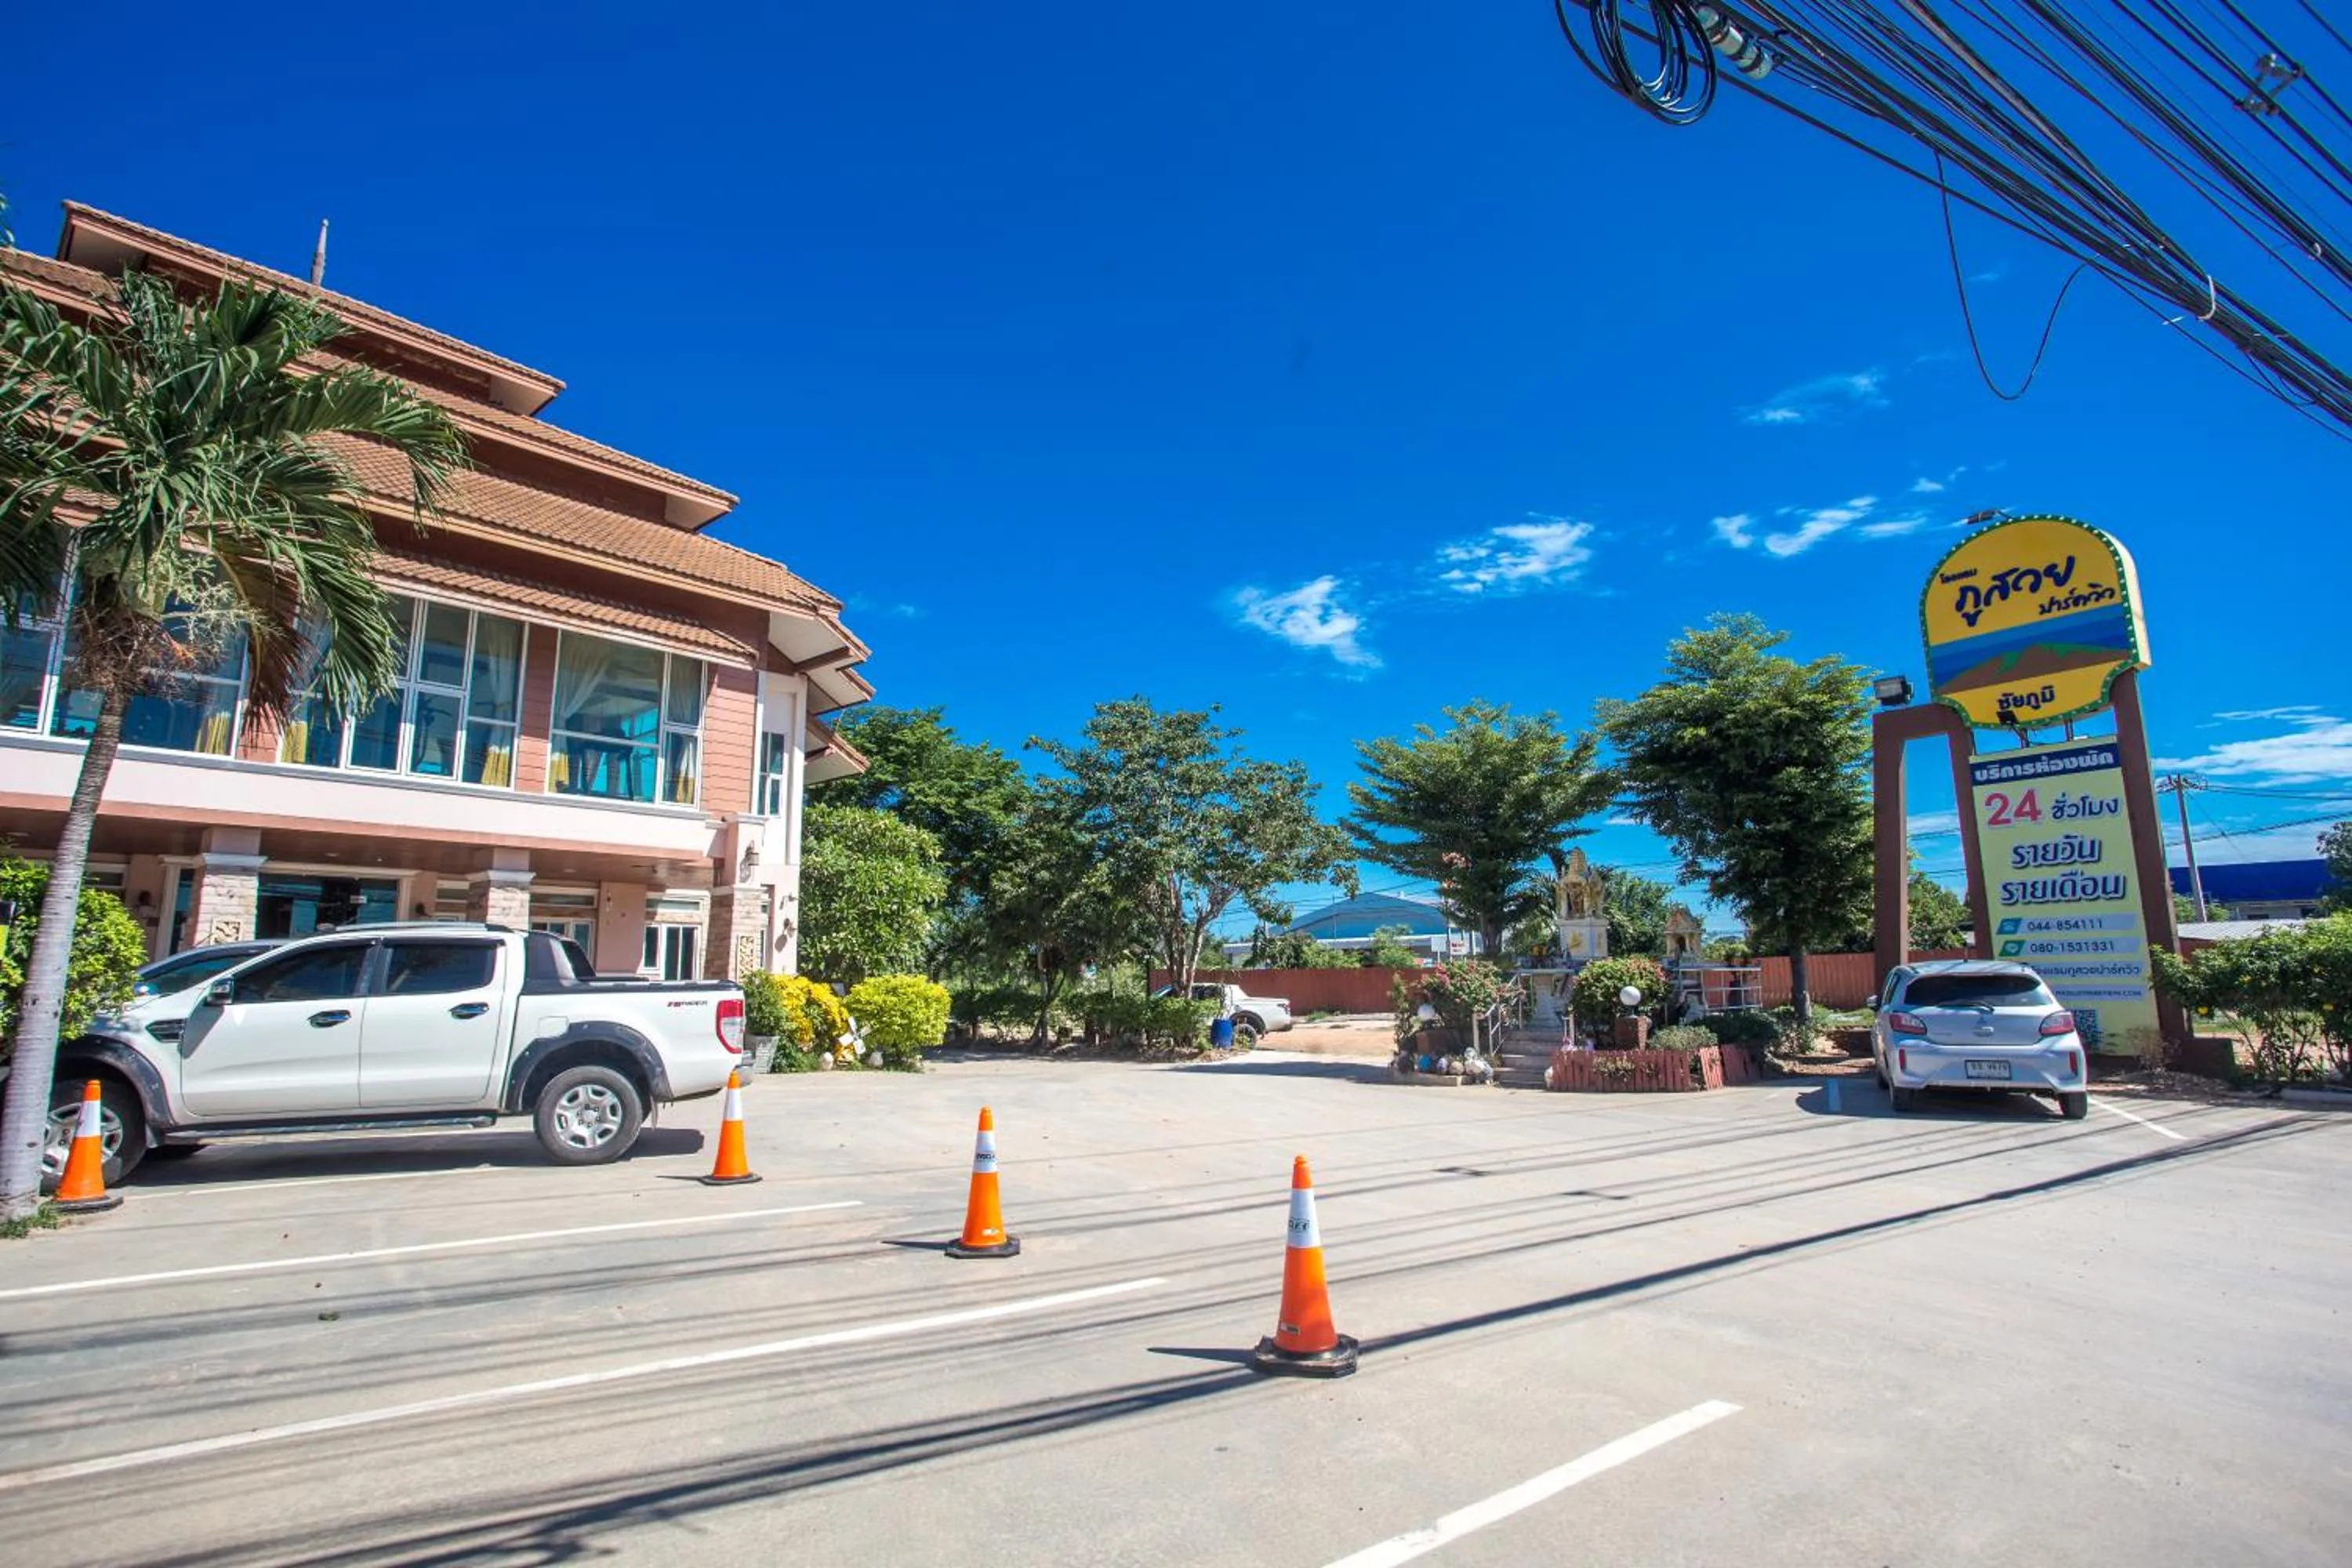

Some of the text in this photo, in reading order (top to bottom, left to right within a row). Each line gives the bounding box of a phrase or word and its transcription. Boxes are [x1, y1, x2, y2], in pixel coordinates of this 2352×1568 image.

[1955, 555, 2076, 628] ภูสวย
[1997, 684, 2056, 710] ชัยภูมิ
[1974, 750, 2114, 782] บริการห้องพัก
[1984, 788, 2119, 826] 24 ชั่วโมง
[2011, 834, 2103, 869] รายวัน
[2001, 869, 2126, 906] รายเดือน
